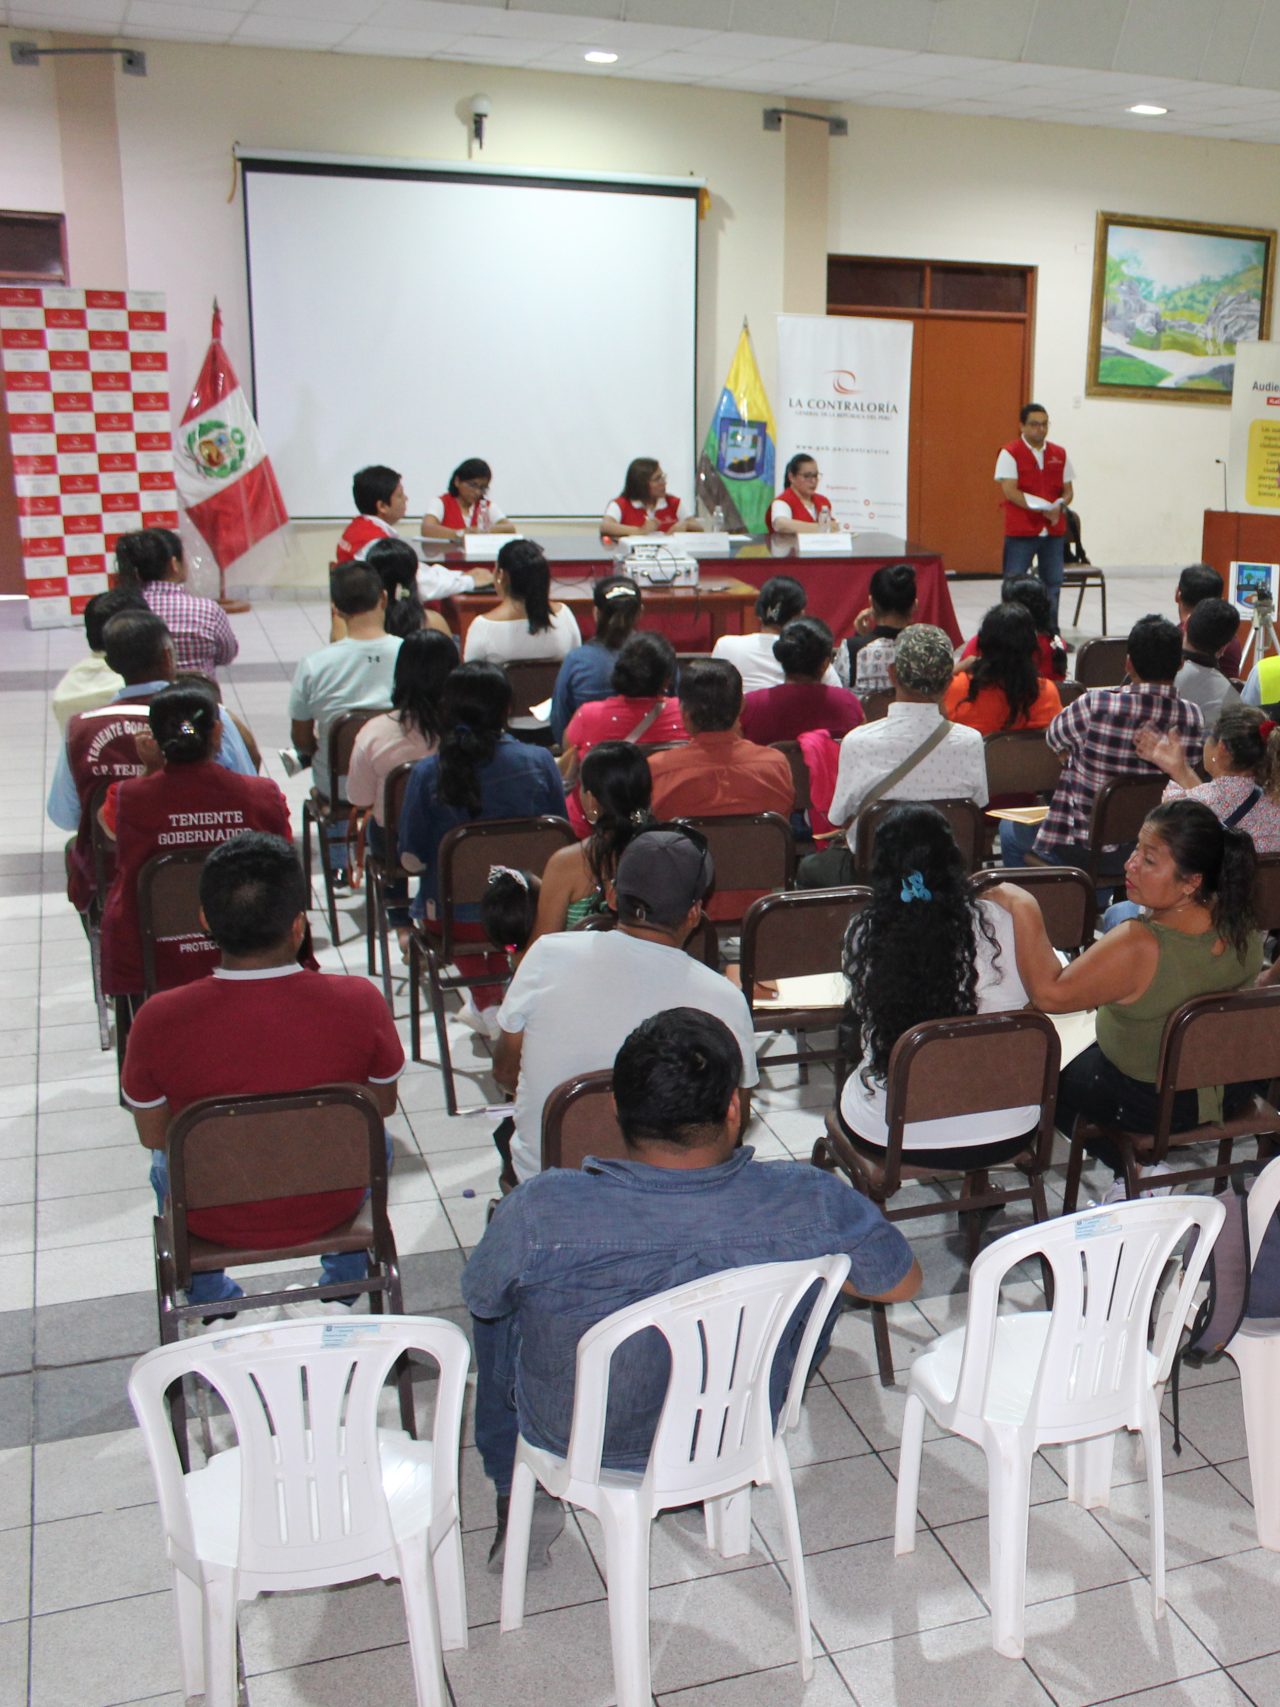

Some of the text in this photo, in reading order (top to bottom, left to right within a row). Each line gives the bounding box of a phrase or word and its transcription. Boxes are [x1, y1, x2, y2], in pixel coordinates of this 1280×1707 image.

[788, 398, 899, 414] LA CONTRALORÍA
[87, 721, 123, 763] TENIENTE
[168, 811, 244, 827] TENIENTE
